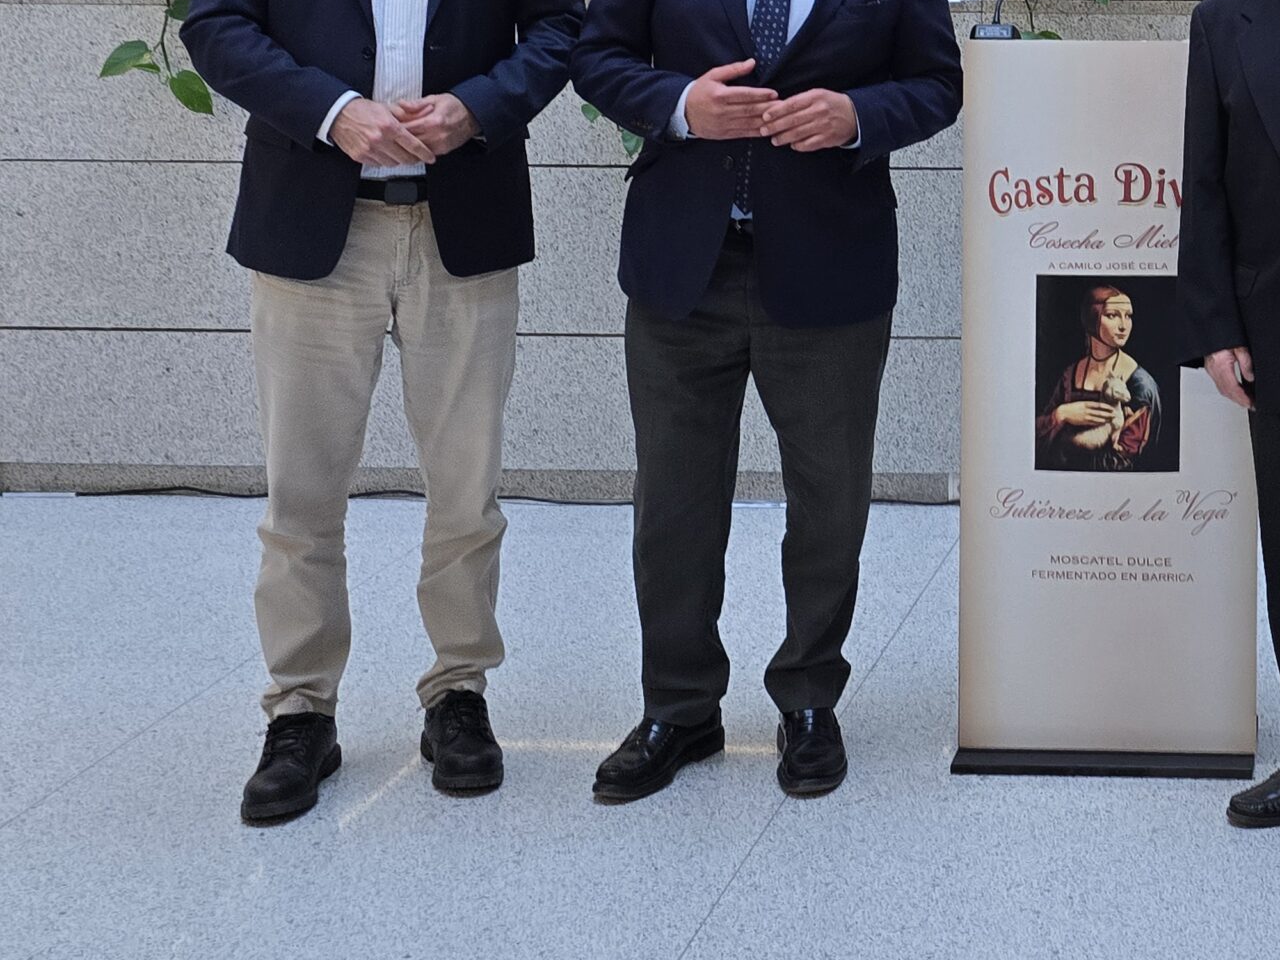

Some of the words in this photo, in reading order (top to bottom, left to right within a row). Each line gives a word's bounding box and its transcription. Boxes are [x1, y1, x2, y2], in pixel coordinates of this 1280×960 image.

[988, 166, 1098, 216] Casta
[1114, 162, 1185, 209] Div
[1028, 220, 1105, 250] Cosecha
[1049, 261, 1057, 271] A
[1058, 261, 1103, 271] CAMILO
[1105, 259, 1136, 271] JOSÉ
[1138, 261, 1169, 271] CELA
[1097, 498, 1132, 522] de
[1138, 498, 1170, 522] la
[1175, 489, 1238, 536] Vega
[1050, 554, 1123, 567] MOSCATEL
[1127, 556, 1173, 568] DULCE
[1031, 569, 1118, 582] FERMENTADO
[1120, 571, 1138, 582] EN
[1141, 572, 1195, 583] BARRICA
